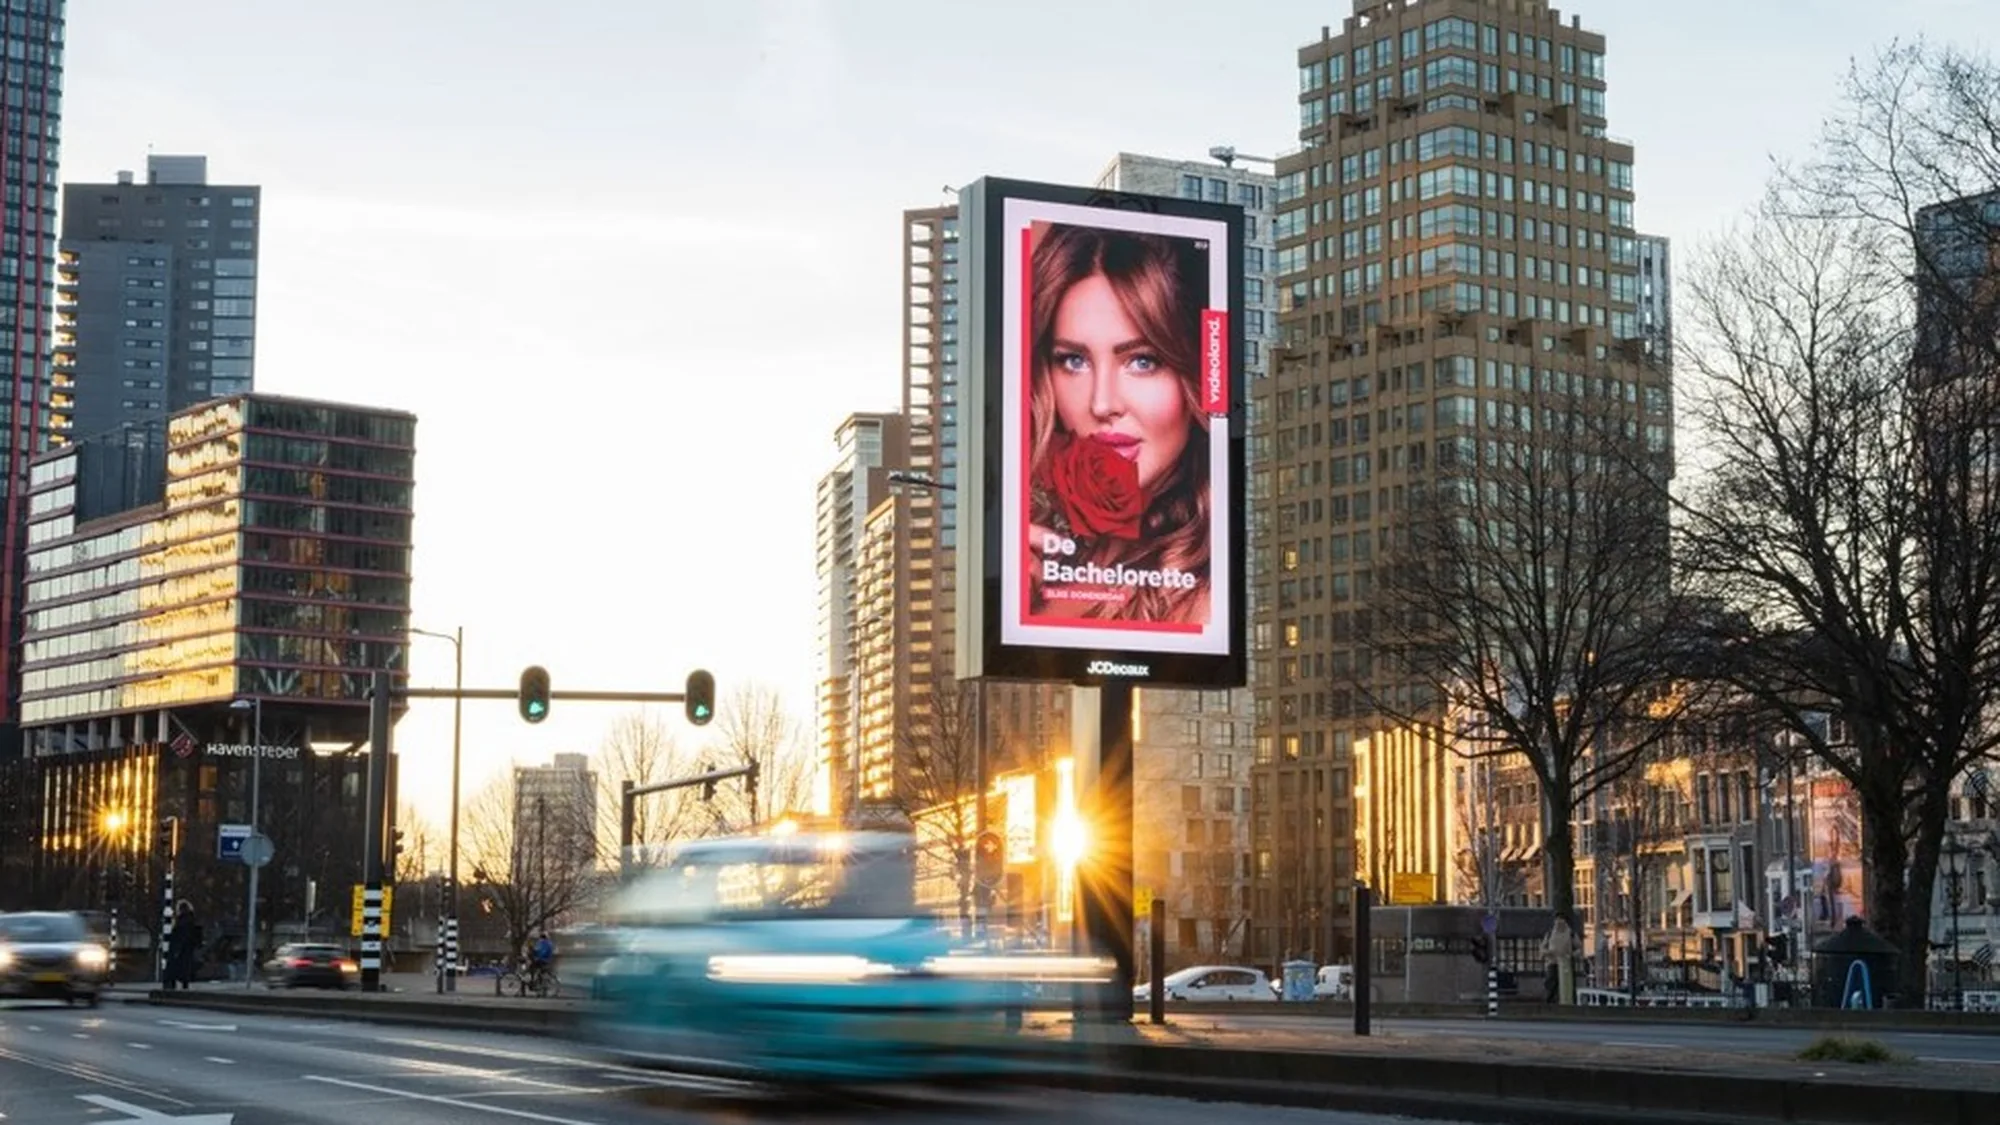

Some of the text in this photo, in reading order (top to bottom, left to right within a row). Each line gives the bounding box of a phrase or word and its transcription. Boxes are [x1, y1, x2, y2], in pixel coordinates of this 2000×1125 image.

[1043, 533, 1076, 555] De
[1043, 559, 1196, 588] Bachelorette
[1086, 660, 1151, 677] JCDecaux
